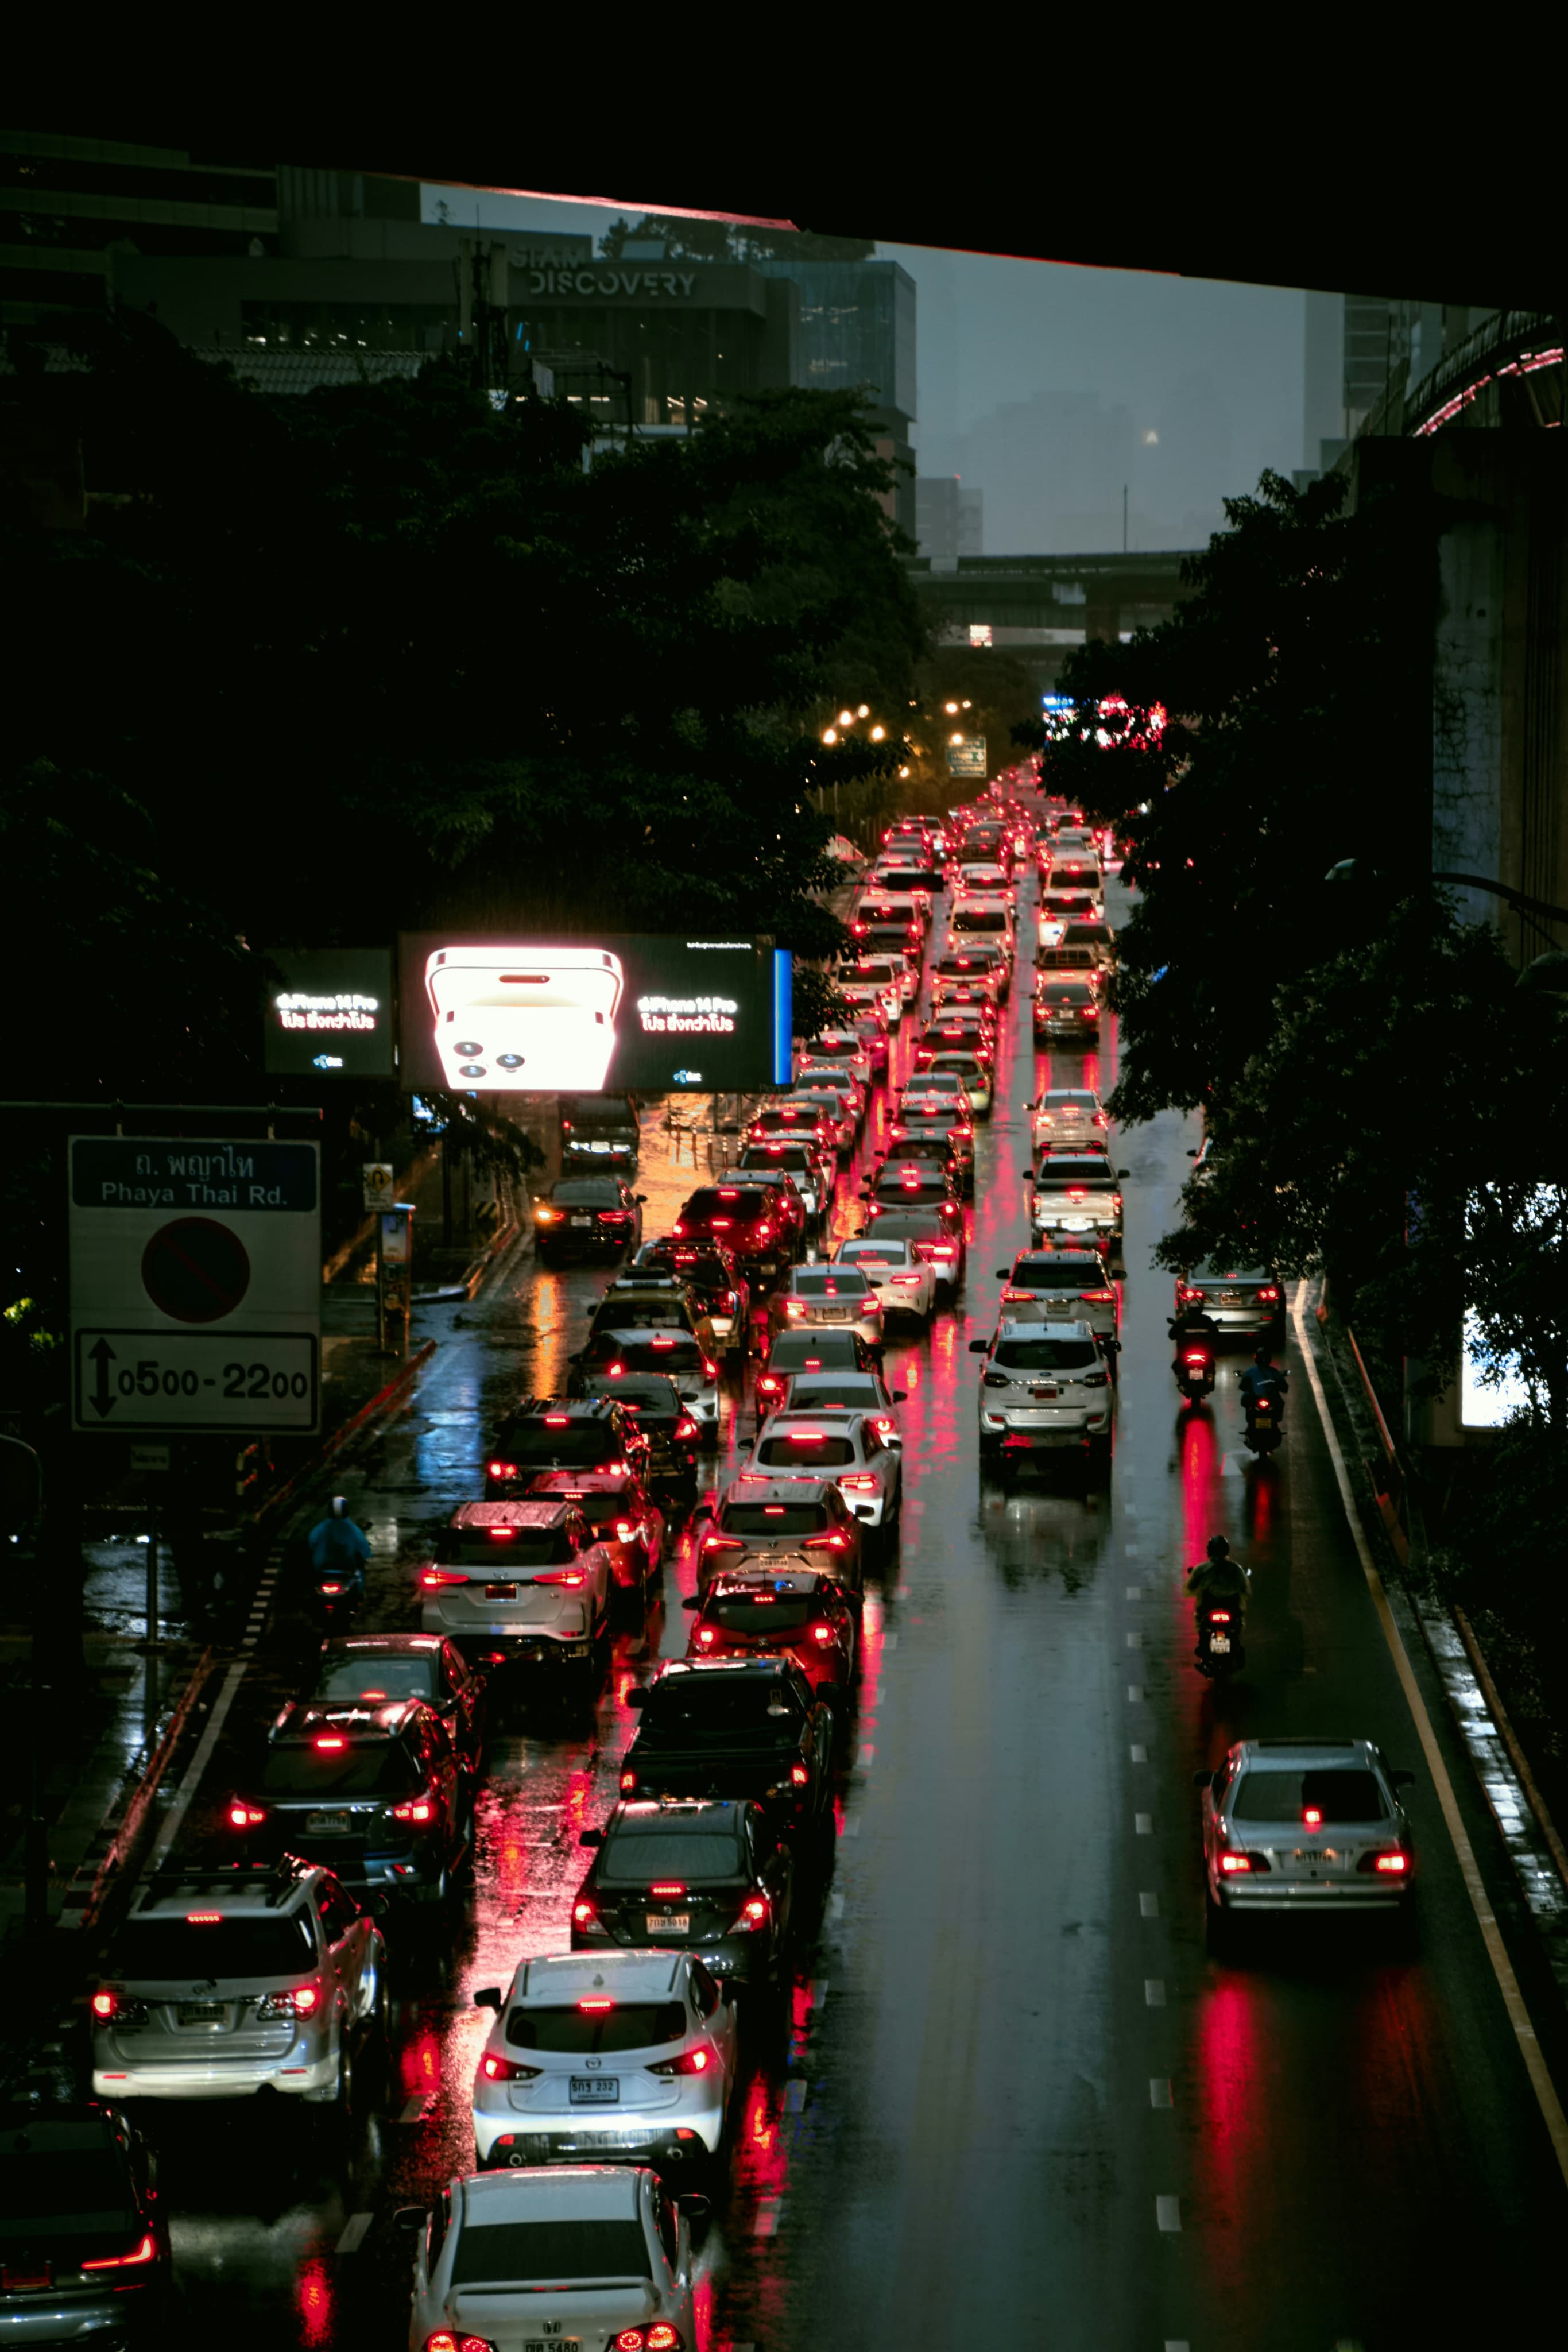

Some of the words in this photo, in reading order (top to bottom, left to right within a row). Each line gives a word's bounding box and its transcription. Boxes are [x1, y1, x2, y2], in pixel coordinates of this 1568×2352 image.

[511, 244, 586, 268] SIAM
[529, 270, 695, 296] DISCOVERY
[712, 997, 737, 1013] Pro
[135, 1154, 160, 1176] ถ.
[166, 1144, 255, 1182] พญาไท
[101, 1181, 175, 1206] Phaya
[185, 1183, 238, 1204] Thai
[249, 1185, 287, 1206] Rd.
[548, 2342, 578, 2352] 5480
